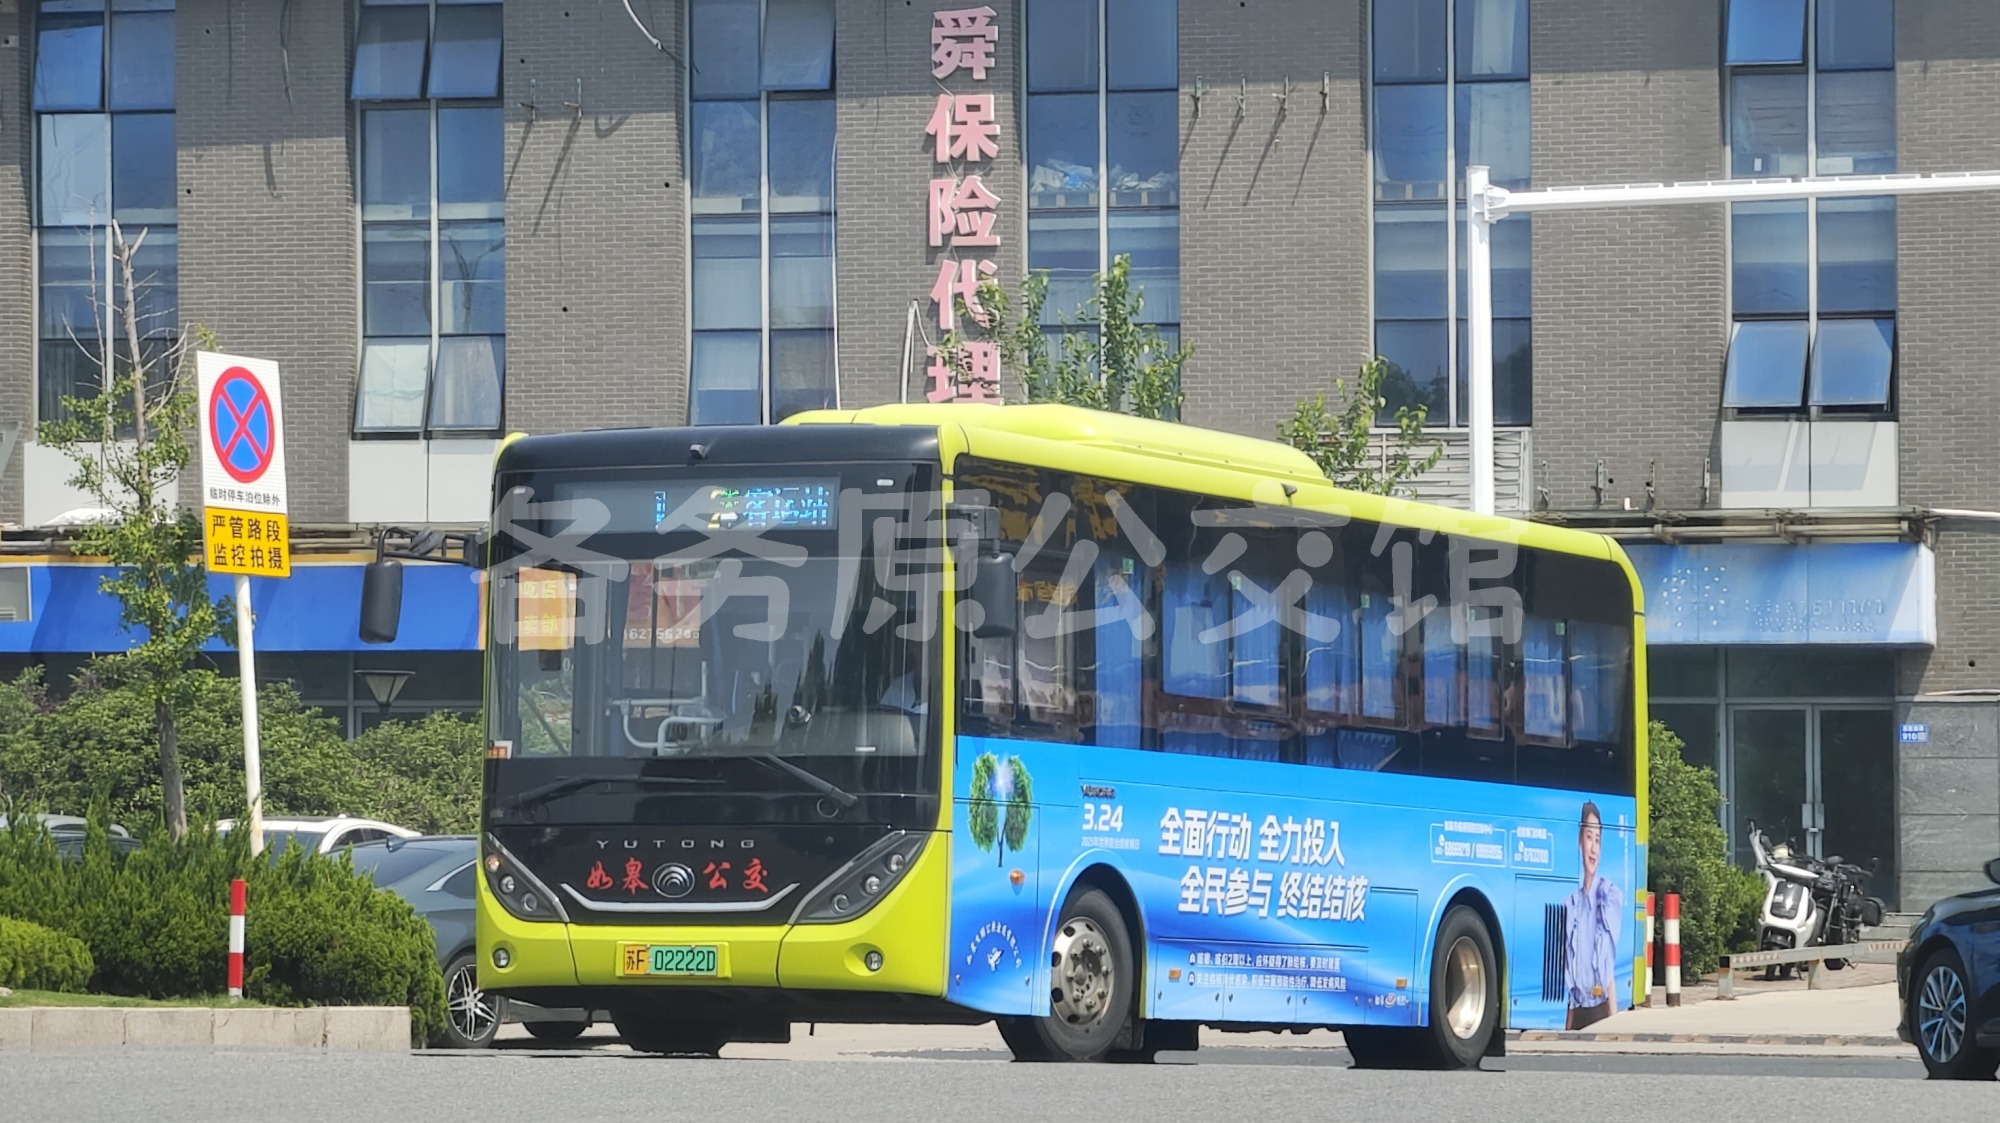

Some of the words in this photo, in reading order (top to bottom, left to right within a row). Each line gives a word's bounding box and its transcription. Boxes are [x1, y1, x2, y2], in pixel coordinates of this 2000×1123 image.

[209, 486, 281, 507] 临时停车泊位除外
[211, 514, 282, 543] 严管路段
[213, 543, 284, 570] 监控拍摄
[519, 579, 558, 600] 吃店
[1081, 802, 1124, 833] 3.24
[596, 839, 755, 849] YUTONG
[1158, 806, 1252, 861] 全面行动
[1257, 814, 1346, 867] 全力投入
[586, 856, 649, 896] 如皋
[702, 857, 770, 893] 公交
[1177, 864, 1274, 918] 全民参与
[1276, 870, 1370, 922] 终结结核
[625, 950, 647, 972] 苏F
[654, 949, 716, 972] 02222D
